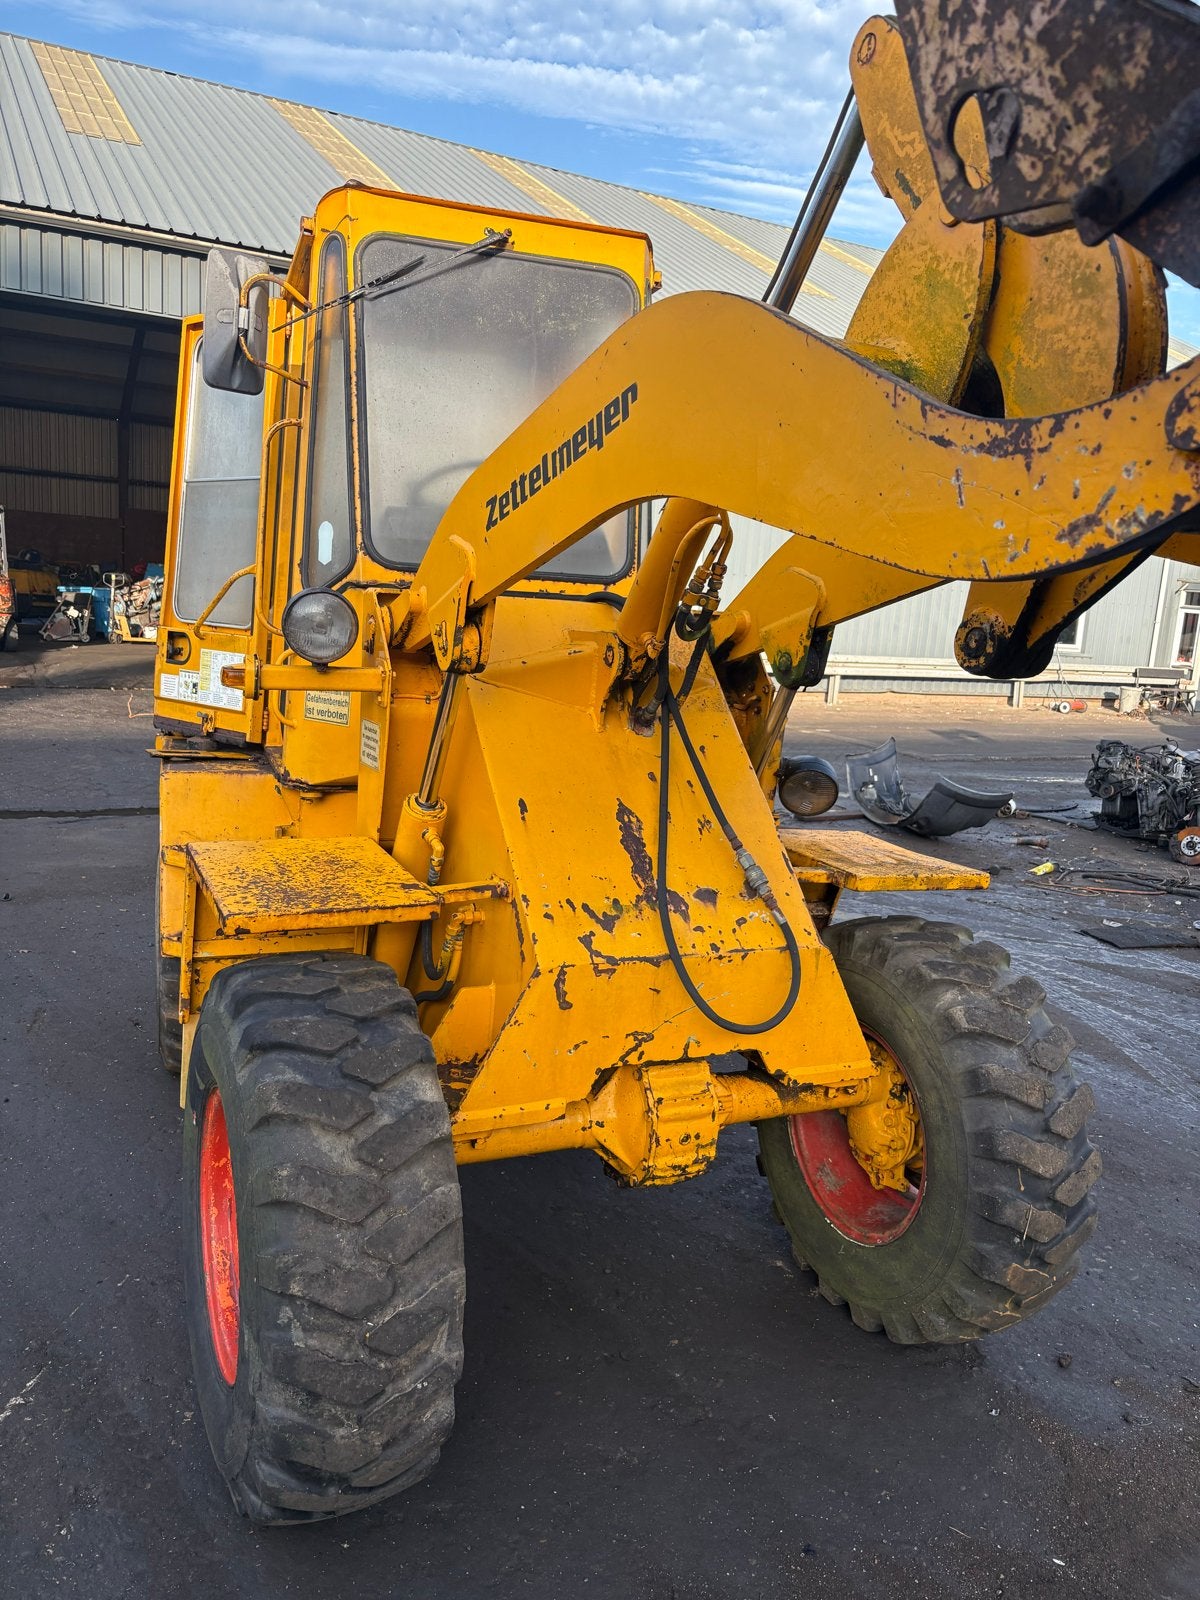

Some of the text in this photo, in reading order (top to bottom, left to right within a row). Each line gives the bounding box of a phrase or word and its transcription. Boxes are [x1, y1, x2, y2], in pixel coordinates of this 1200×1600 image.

[485, 381, 638, 532] Zettelmeyer
[306, 693, 348, 707] Gefahrenbereich
[306, 705, 348, 721] ist verboten
